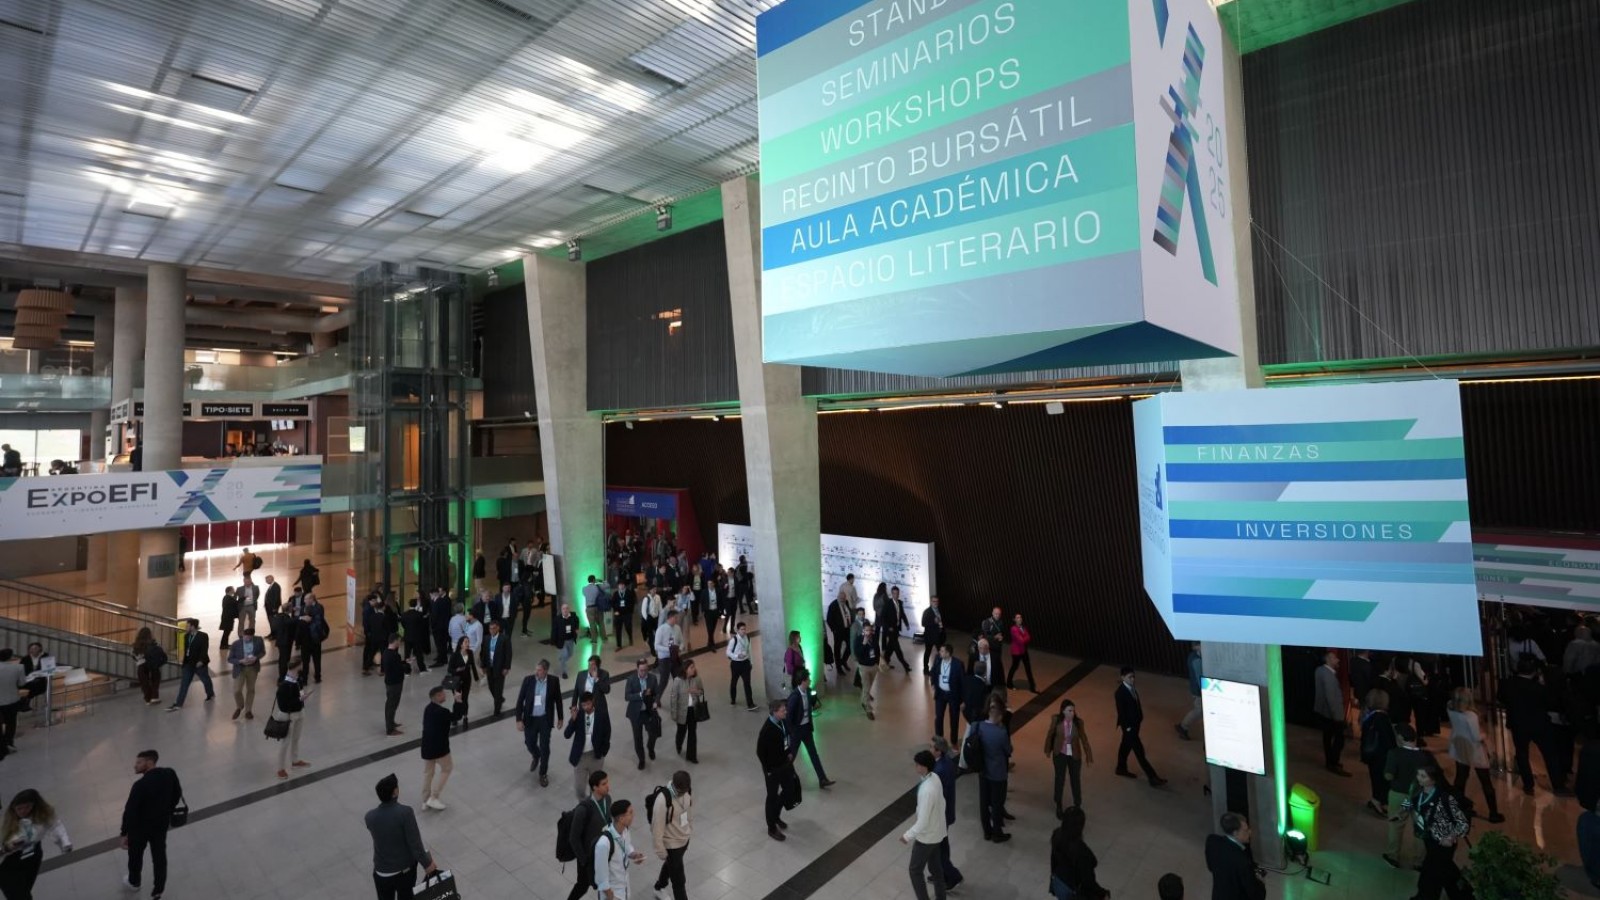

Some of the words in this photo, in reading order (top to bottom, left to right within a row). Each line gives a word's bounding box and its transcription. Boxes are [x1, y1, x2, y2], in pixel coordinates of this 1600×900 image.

[821, 3, 1018, 107] SEMINARIOS
[820, 57, 1022, 154] WORKSHOPS
[782, 156, 896, 214] RECINTO
[907, 95, 1092, 176] BURSÁTIL
[790, 212, 860, 254] AULA
[869, 153, 1079, 236] ACADÉMICA
[780, 254, 896, 299] ESPACIO
[907, 209, 1102, 277] LITERARIO
[1197, 443, 1320, 461] FINANZAS
[1235, 521, 1414, 540] INVERSIONES
